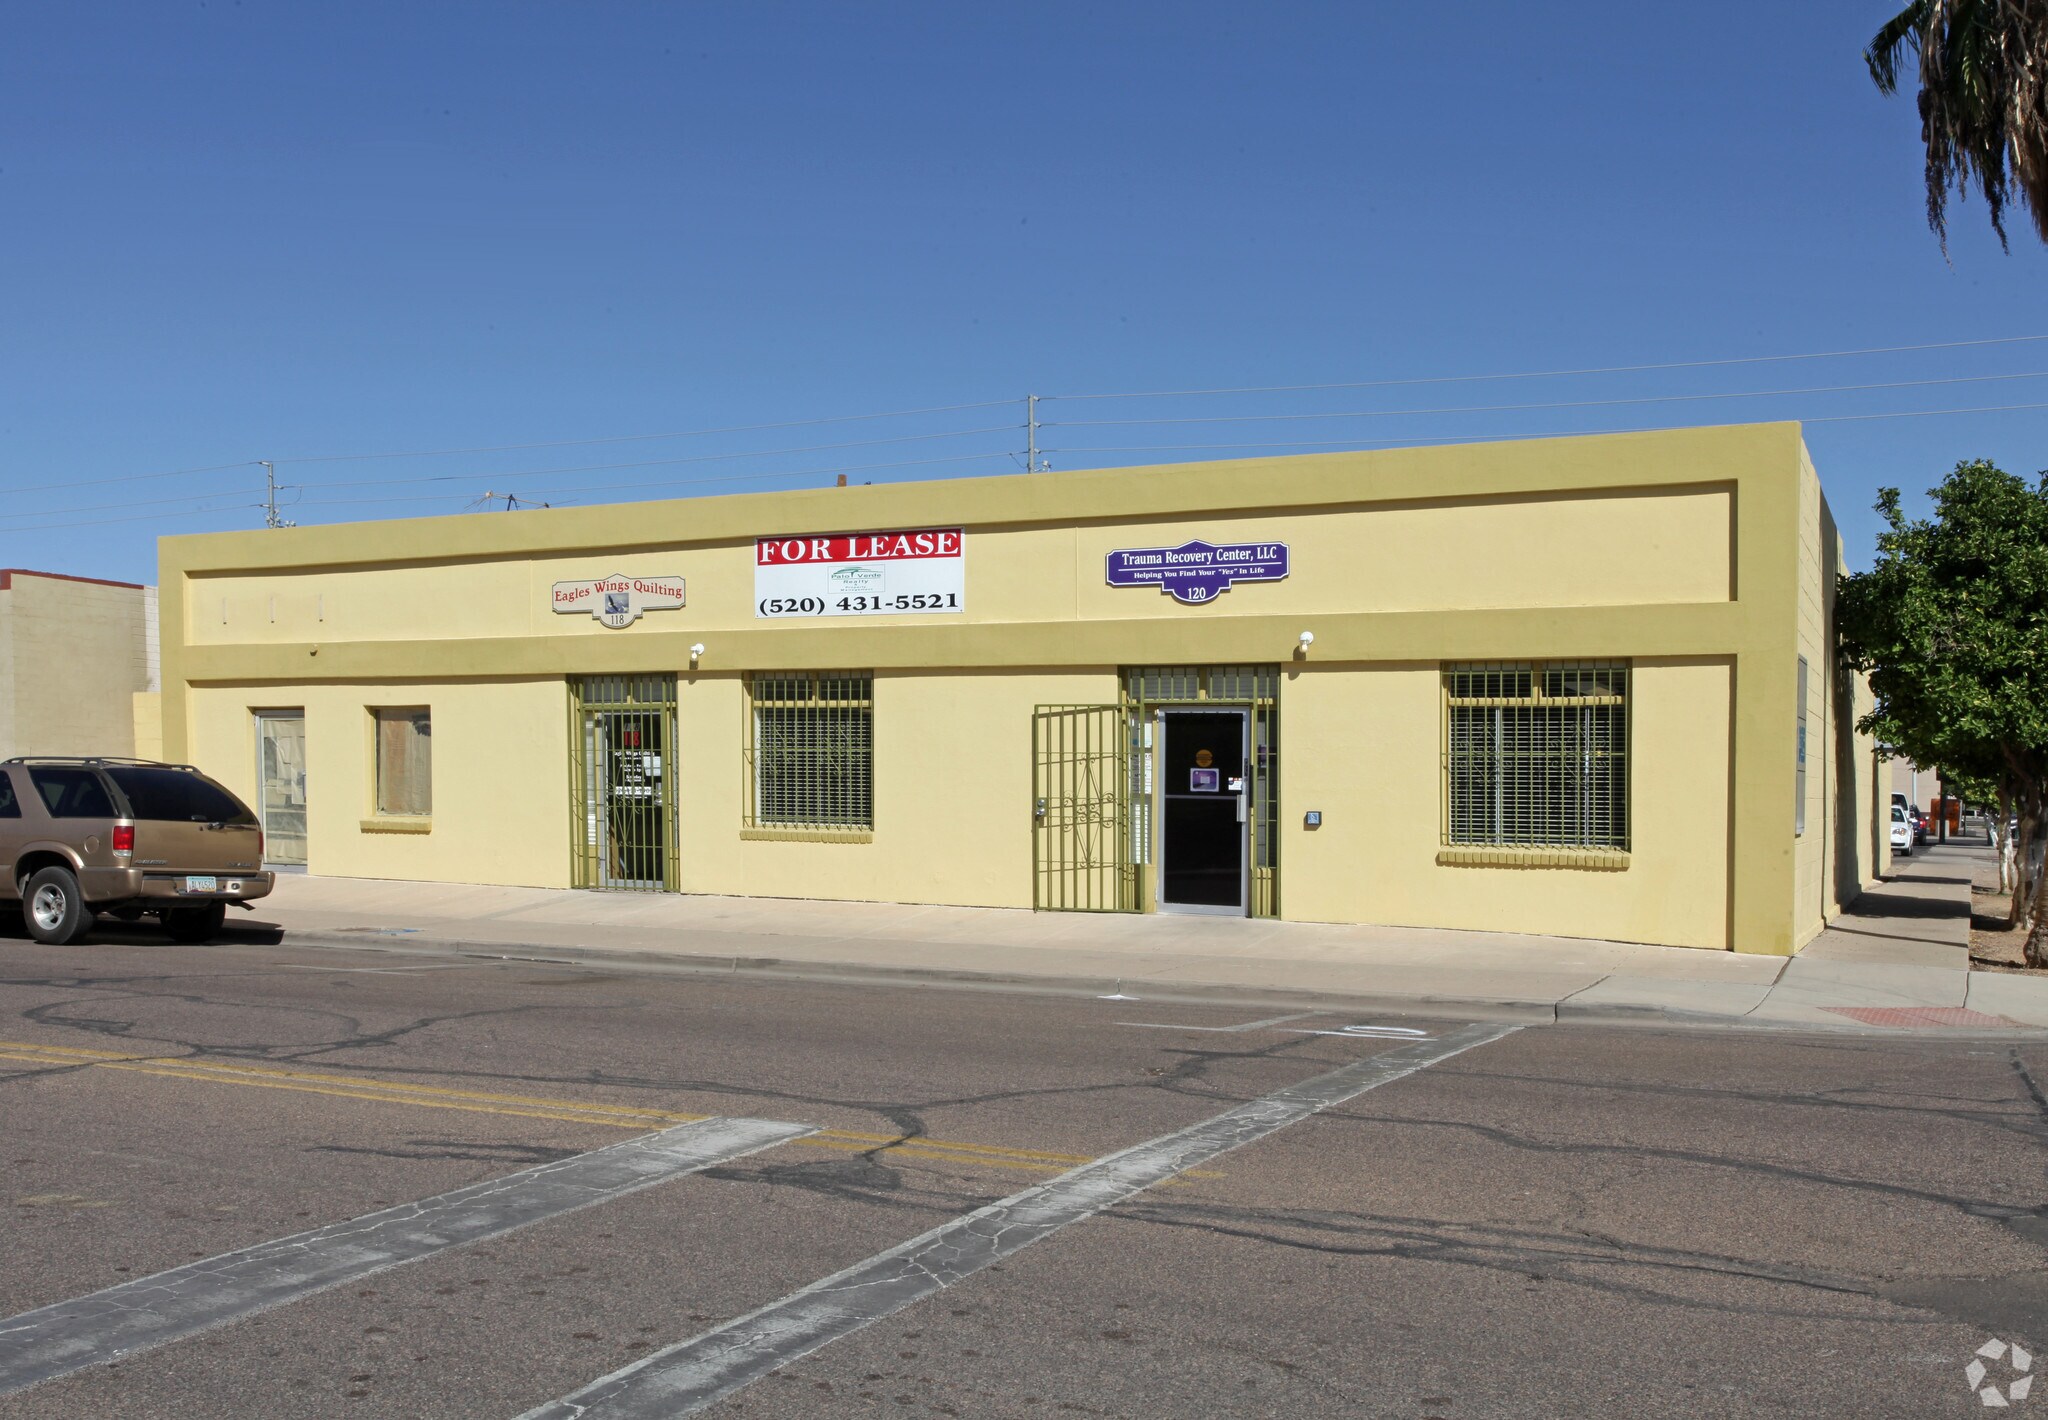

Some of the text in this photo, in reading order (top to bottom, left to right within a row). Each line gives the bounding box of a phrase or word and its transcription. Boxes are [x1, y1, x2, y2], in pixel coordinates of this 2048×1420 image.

[760, 532, 959, 563] FOR LEASE
[1122, 546, 1277, 565] Trauma Recovery Center, LLC
[1134, 571, 1162, 579] Helping
[555, 580, 683, 602] Eagles Wings Quilting
[1187, 587, 1206, 600] 120
[759, 593, 959, 616] (520) 431-5521
[610, 615, 625, 625] 118
